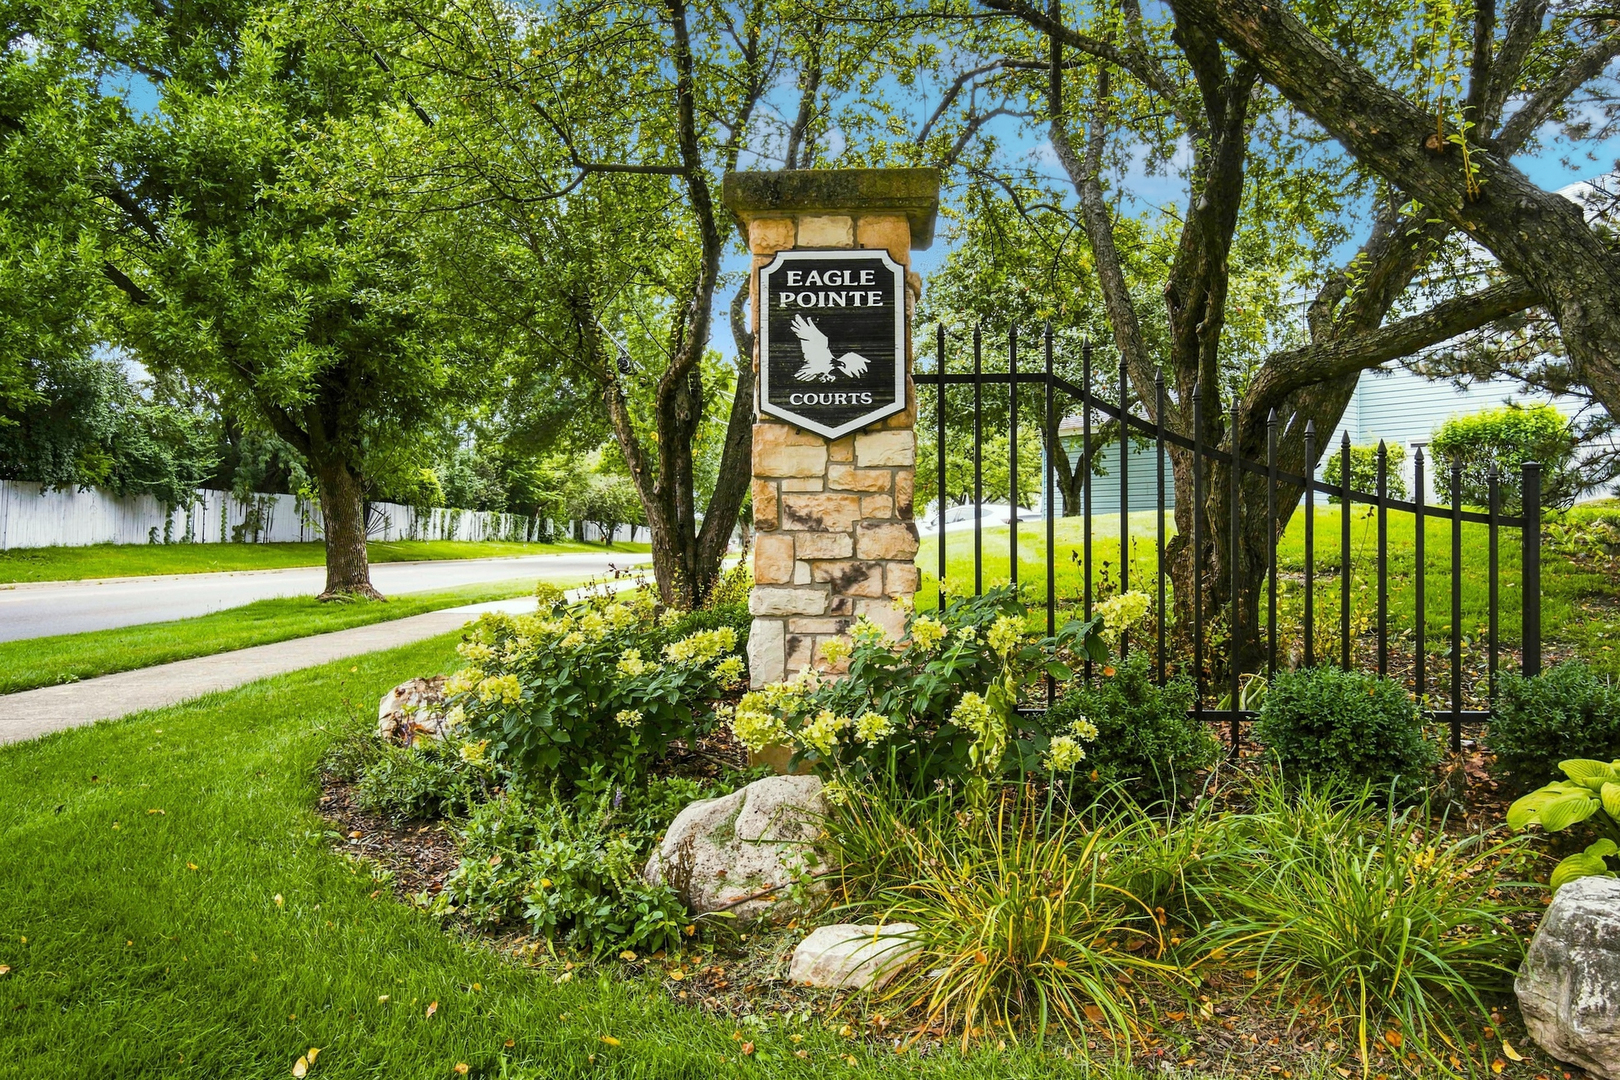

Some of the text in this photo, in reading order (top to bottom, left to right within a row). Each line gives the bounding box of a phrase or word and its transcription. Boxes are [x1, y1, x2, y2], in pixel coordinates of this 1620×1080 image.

[786, 269, 876, 287] EAGLE
[779, 290, 884, 308] POINTE
[789, 392, 873, 406] COURTS
